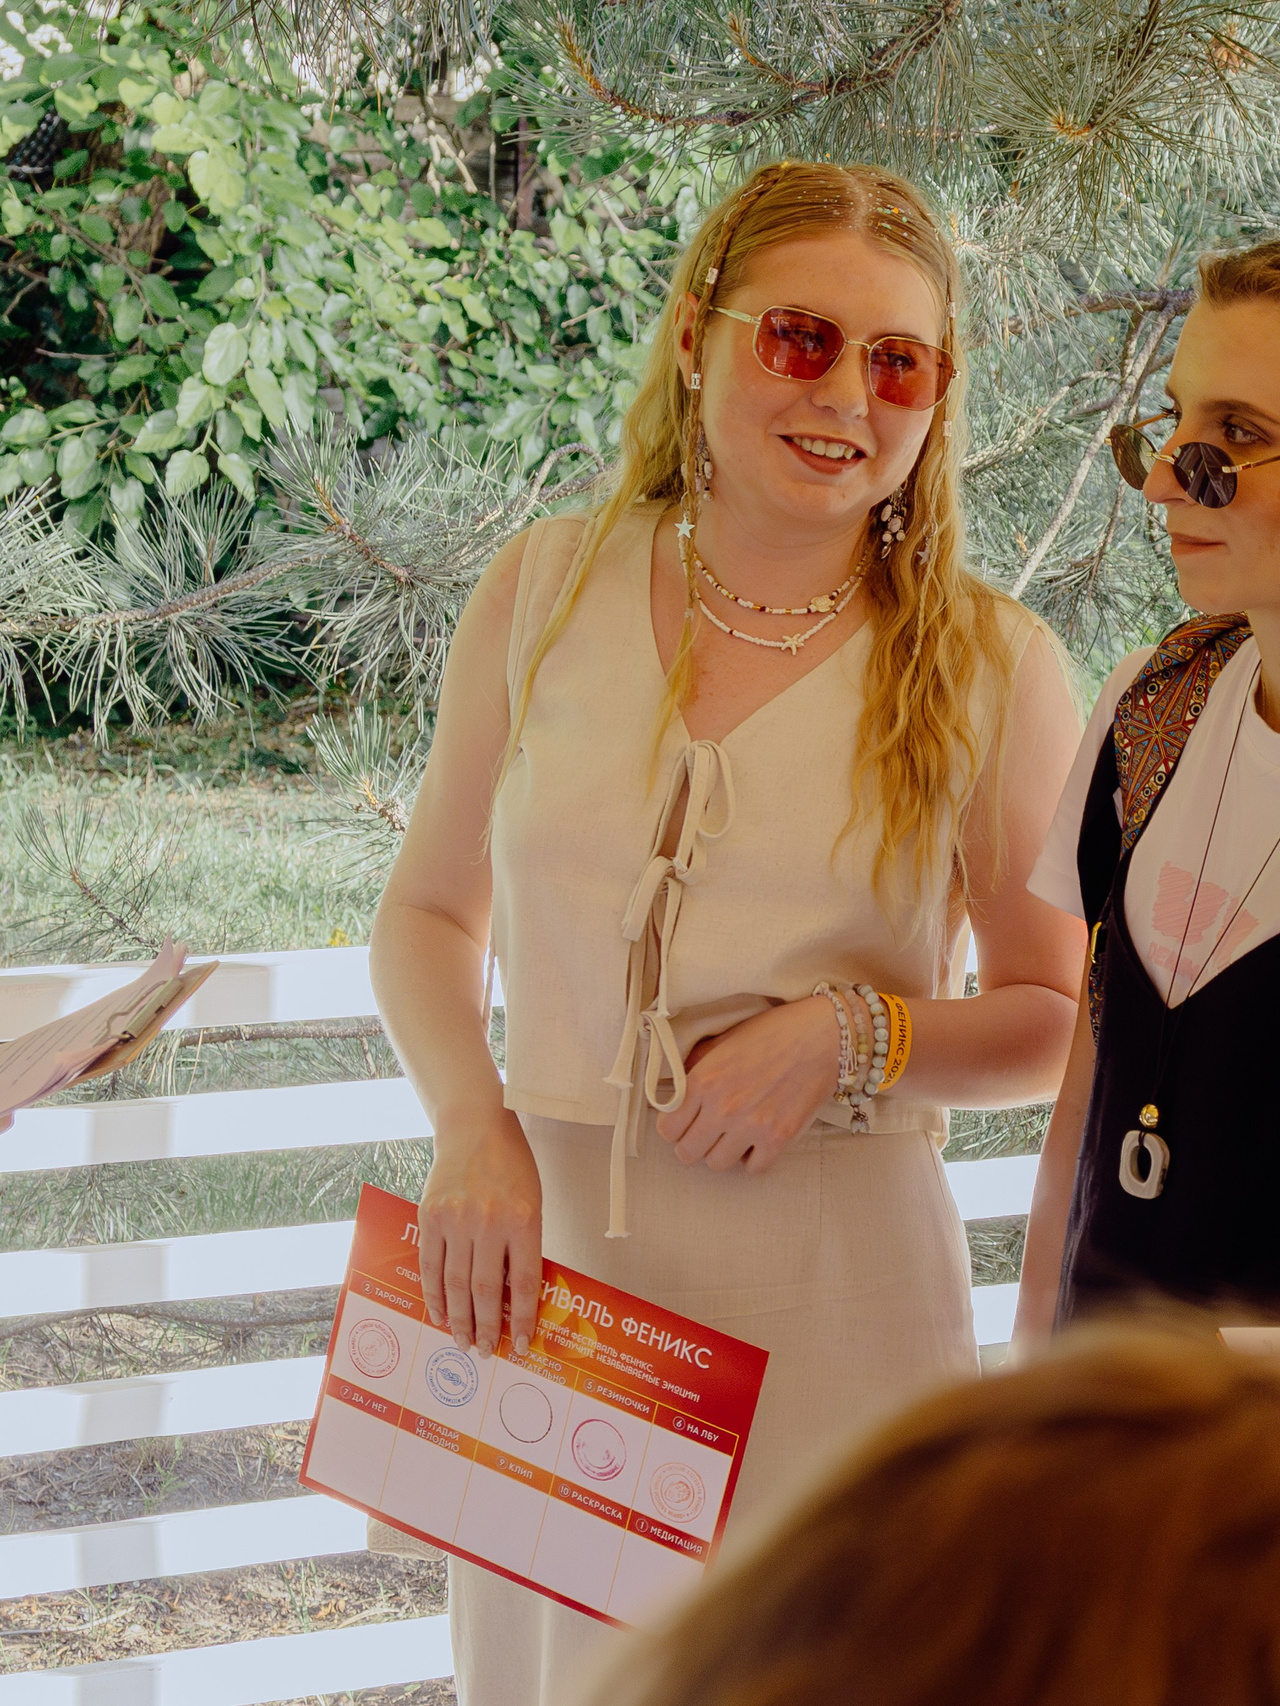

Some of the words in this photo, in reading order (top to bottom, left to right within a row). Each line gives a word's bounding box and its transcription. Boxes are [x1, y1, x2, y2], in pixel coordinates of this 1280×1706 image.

[895, 1002, 907, 1056] ФЕНИКС
[374, 1287, 413, 1309] ТАРОЛОГ
[395, 1266, 422, 1282] СЛЕДУ
[546, 1330, 553, 1340] И
[554, 1334, 594, 1358] ПОЛУЧИТЕ
[596, 1352, 660, 1386] НЕЗАБЫВАЕМЫЕ
[661, 1380, 700, 1402] ЭМОЦИИ!
[541, 1280, 613, 1327] ИВАЛЬ
[620, 1317, 712, 1368] ФЕНИКС
[538, 1317, 570, 1336] ЛЕТНИЙ
[570, 1332, 617, 1357] ФЕСТИВАЛЬ
[619, 1352, 653, 1374] ФЕНИКС,
[506, 1353, 566, 1385] ТРОГАТЕЛЬНО
[351, 1392, 363, 1403] ДА
[371, 1401, 387, 1413] НЕТ
[596, 1384, 649, 1413] РЕЗИНОЧКИ
[415, 1427, 459, 1452] МЕЛОДИЮ
[428, 1420, 459, 1440] УГАДАЙ
[686, 1423, 698, 1434] НА
[700, 1429, 719, 1441] ЛБУ
[508, 1462, 532, 1479] КЛИП
[571, 1490, 622, 1519] РАСКРАСКА
[649, 1525, 702, 1555] МЕДИТАЦИЯ
